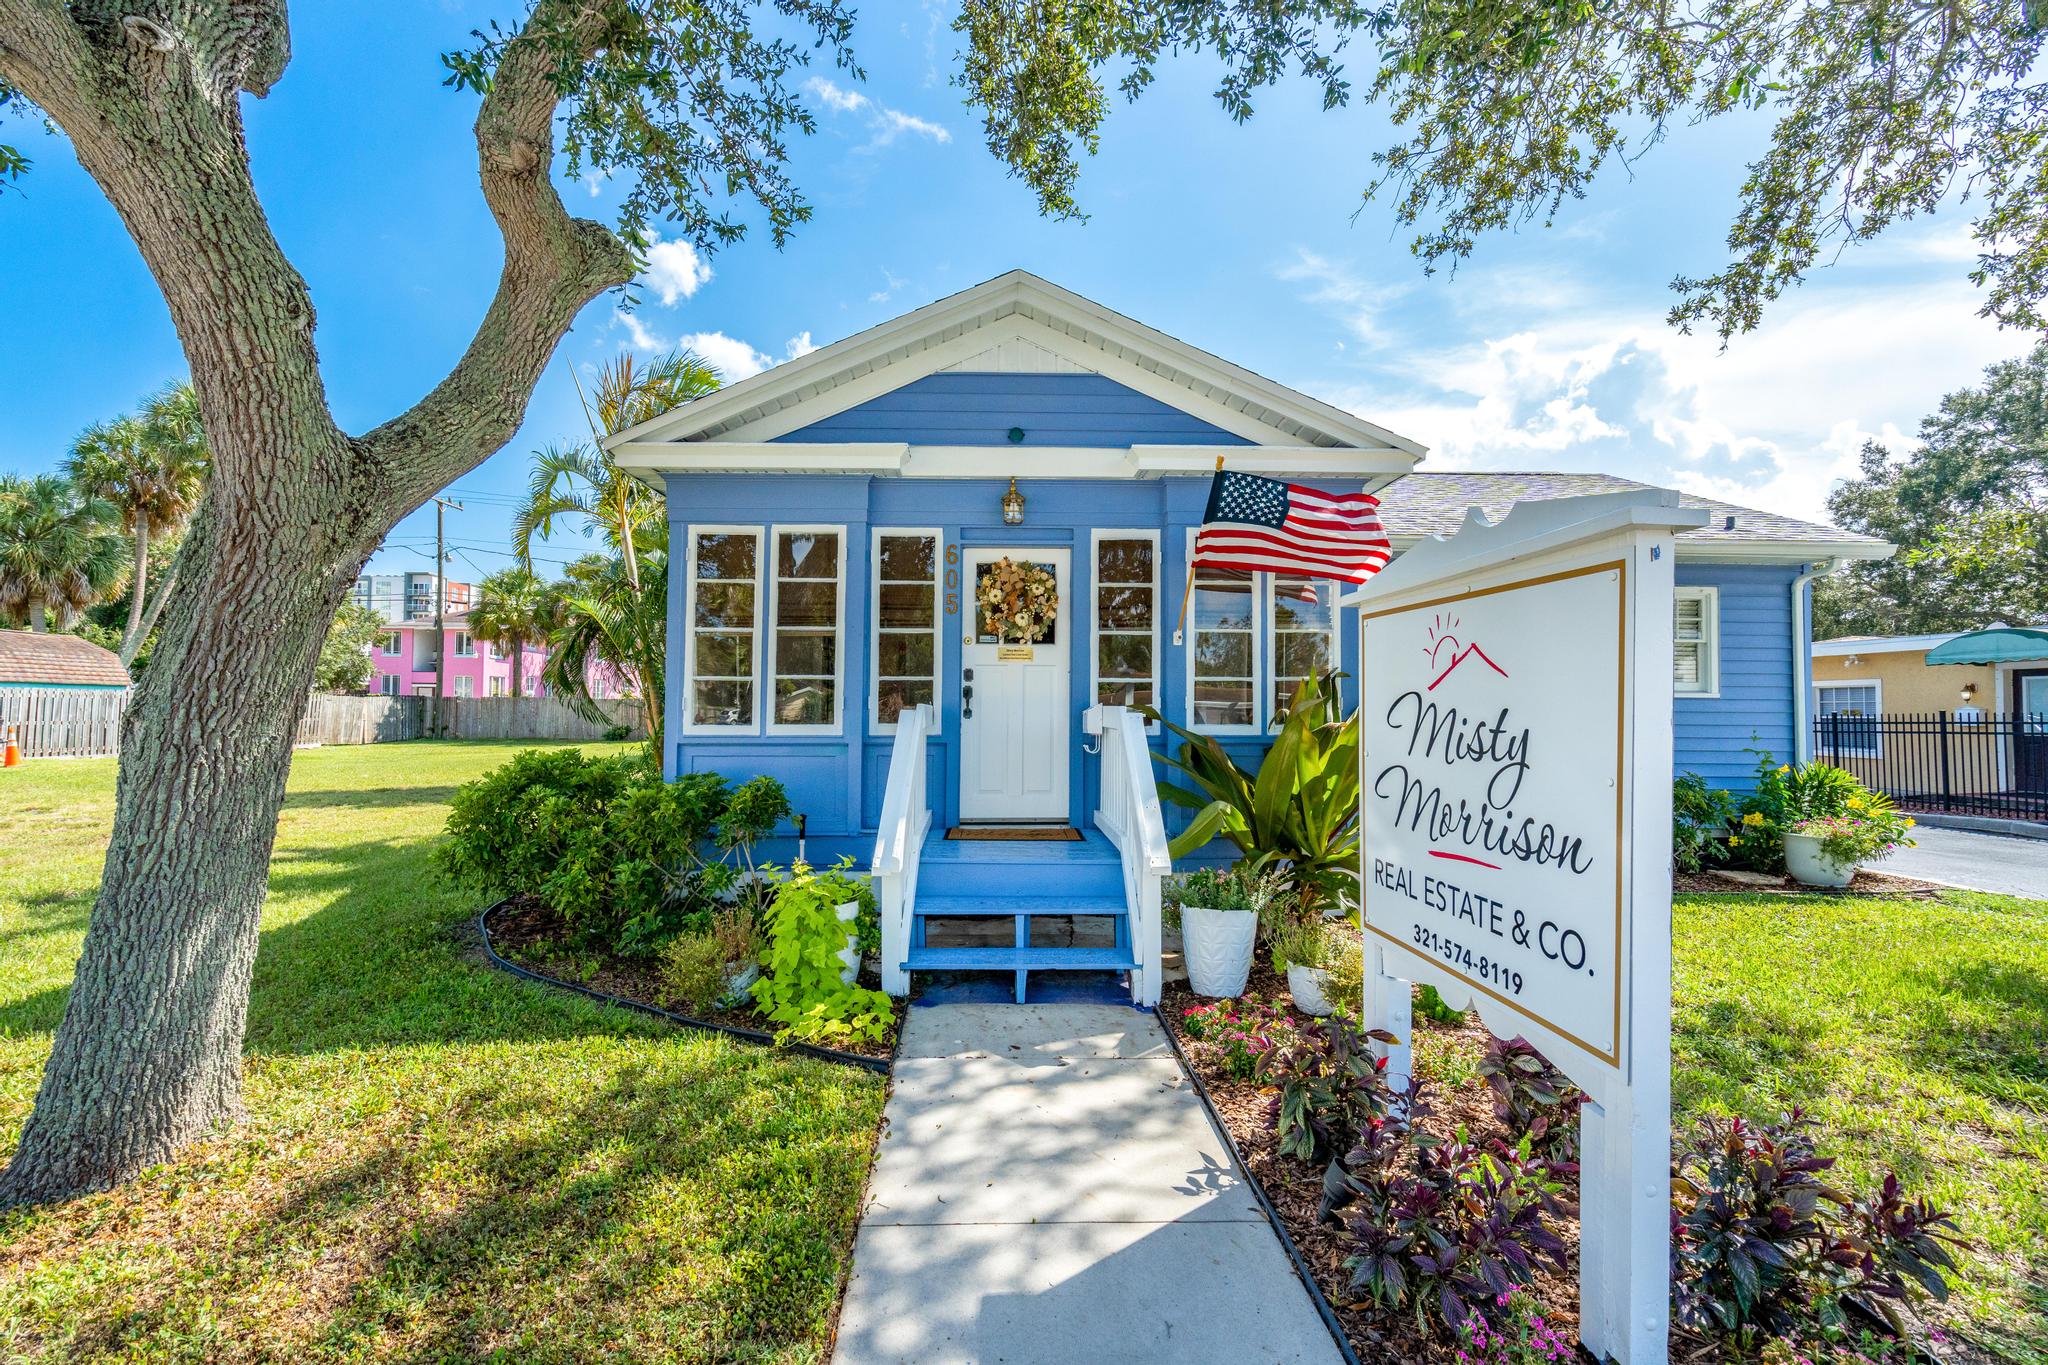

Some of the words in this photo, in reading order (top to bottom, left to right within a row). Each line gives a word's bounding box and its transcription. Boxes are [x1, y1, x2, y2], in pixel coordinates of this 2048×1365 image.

[946, 545, 957, 614] 605
[1387, 691, 1530, 810] Misty
[1375, 765, 1593, 874] Morrison
[1375, 858, 1417, 901] REAL
[1424, 876, 1503, 937] ESTATE
[1511, 909, 1531, 950] &
[1538, 920, 1595, 977] CO.
[1413, 923, 1523, 996] 321-574-8119
